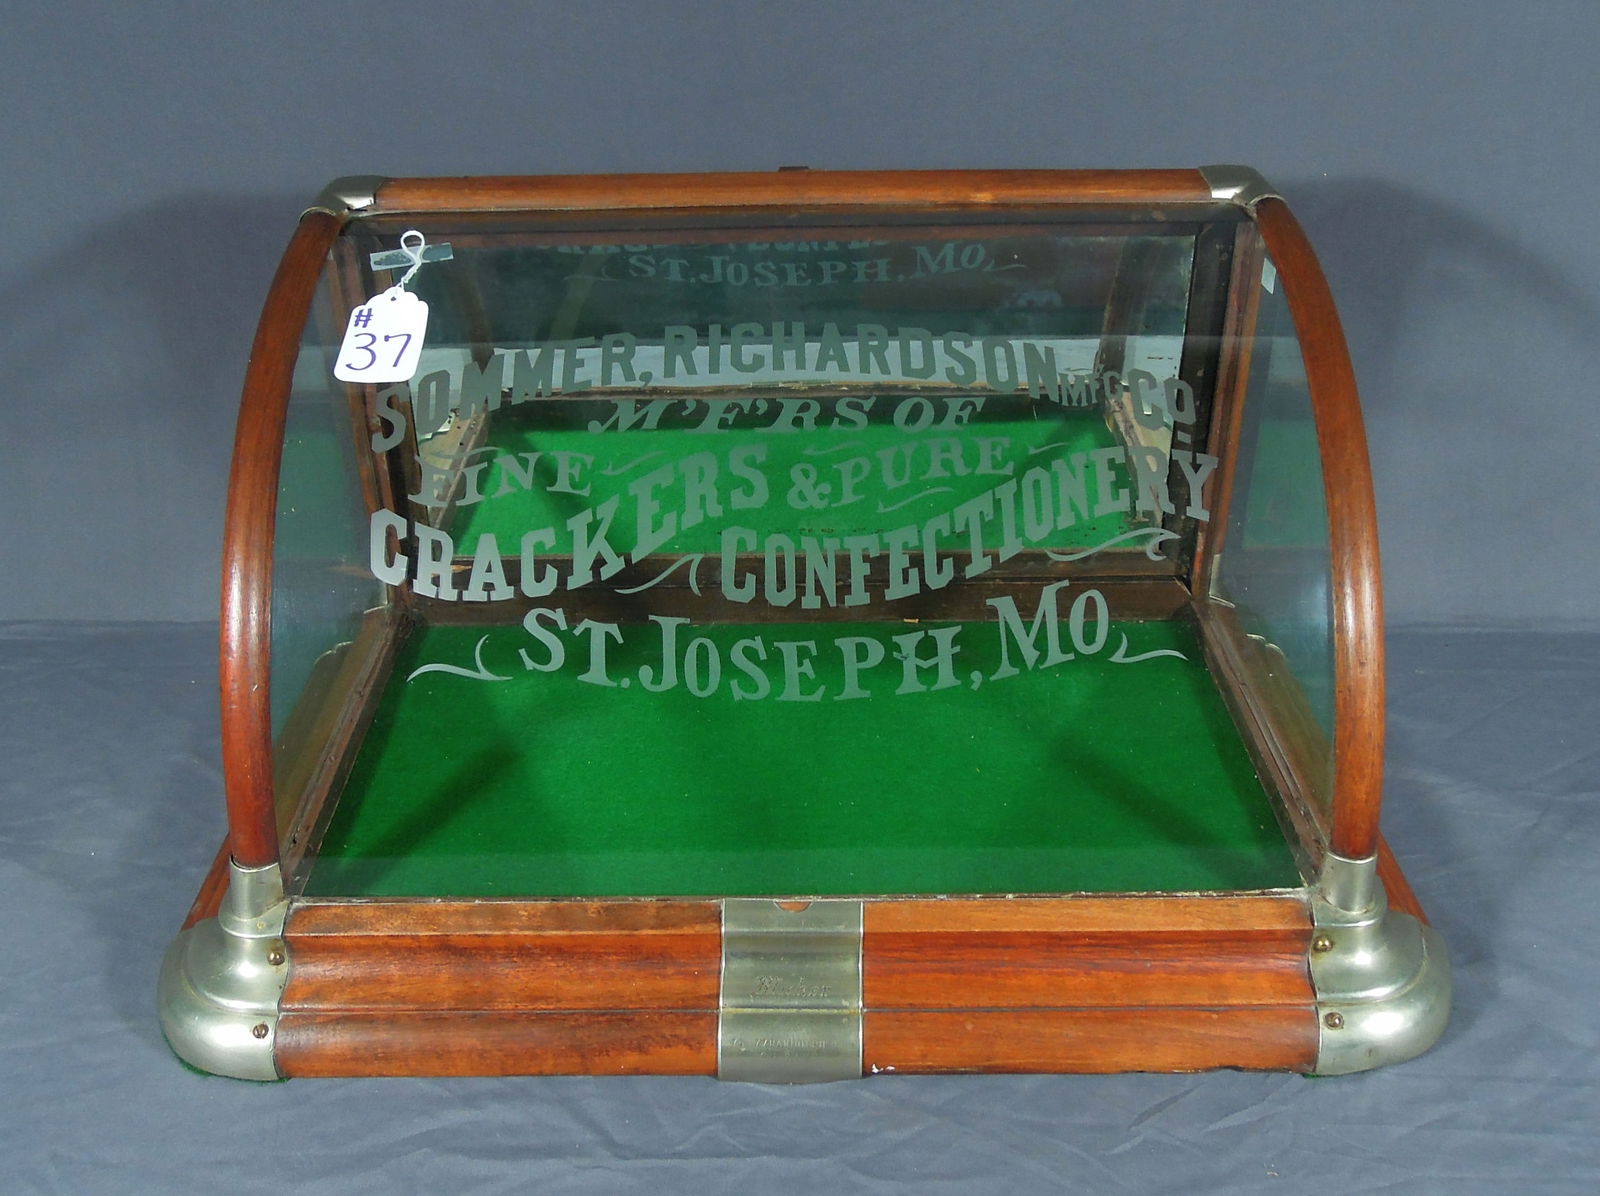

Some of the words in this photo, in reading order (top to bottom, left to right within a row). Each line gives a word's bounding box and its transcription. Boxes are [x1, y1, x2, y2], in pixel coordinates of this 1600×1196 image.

[354, 308, 373, 328] #
[346, 333, 412, 371] 37
[371, 335, 654, 454] SOMMER,
[663, 321, 1058, 402] RICHARDSON
[893, 396, 986, 432] OF
[408, 451, 594, 506] FINE
[787, 463, 831, 510] &
[831, 436, 1015, 508] PURE
[370, 443, 770, 602] CRACKERS
[721, 446, 1218, 609] CONFECTIONERY
